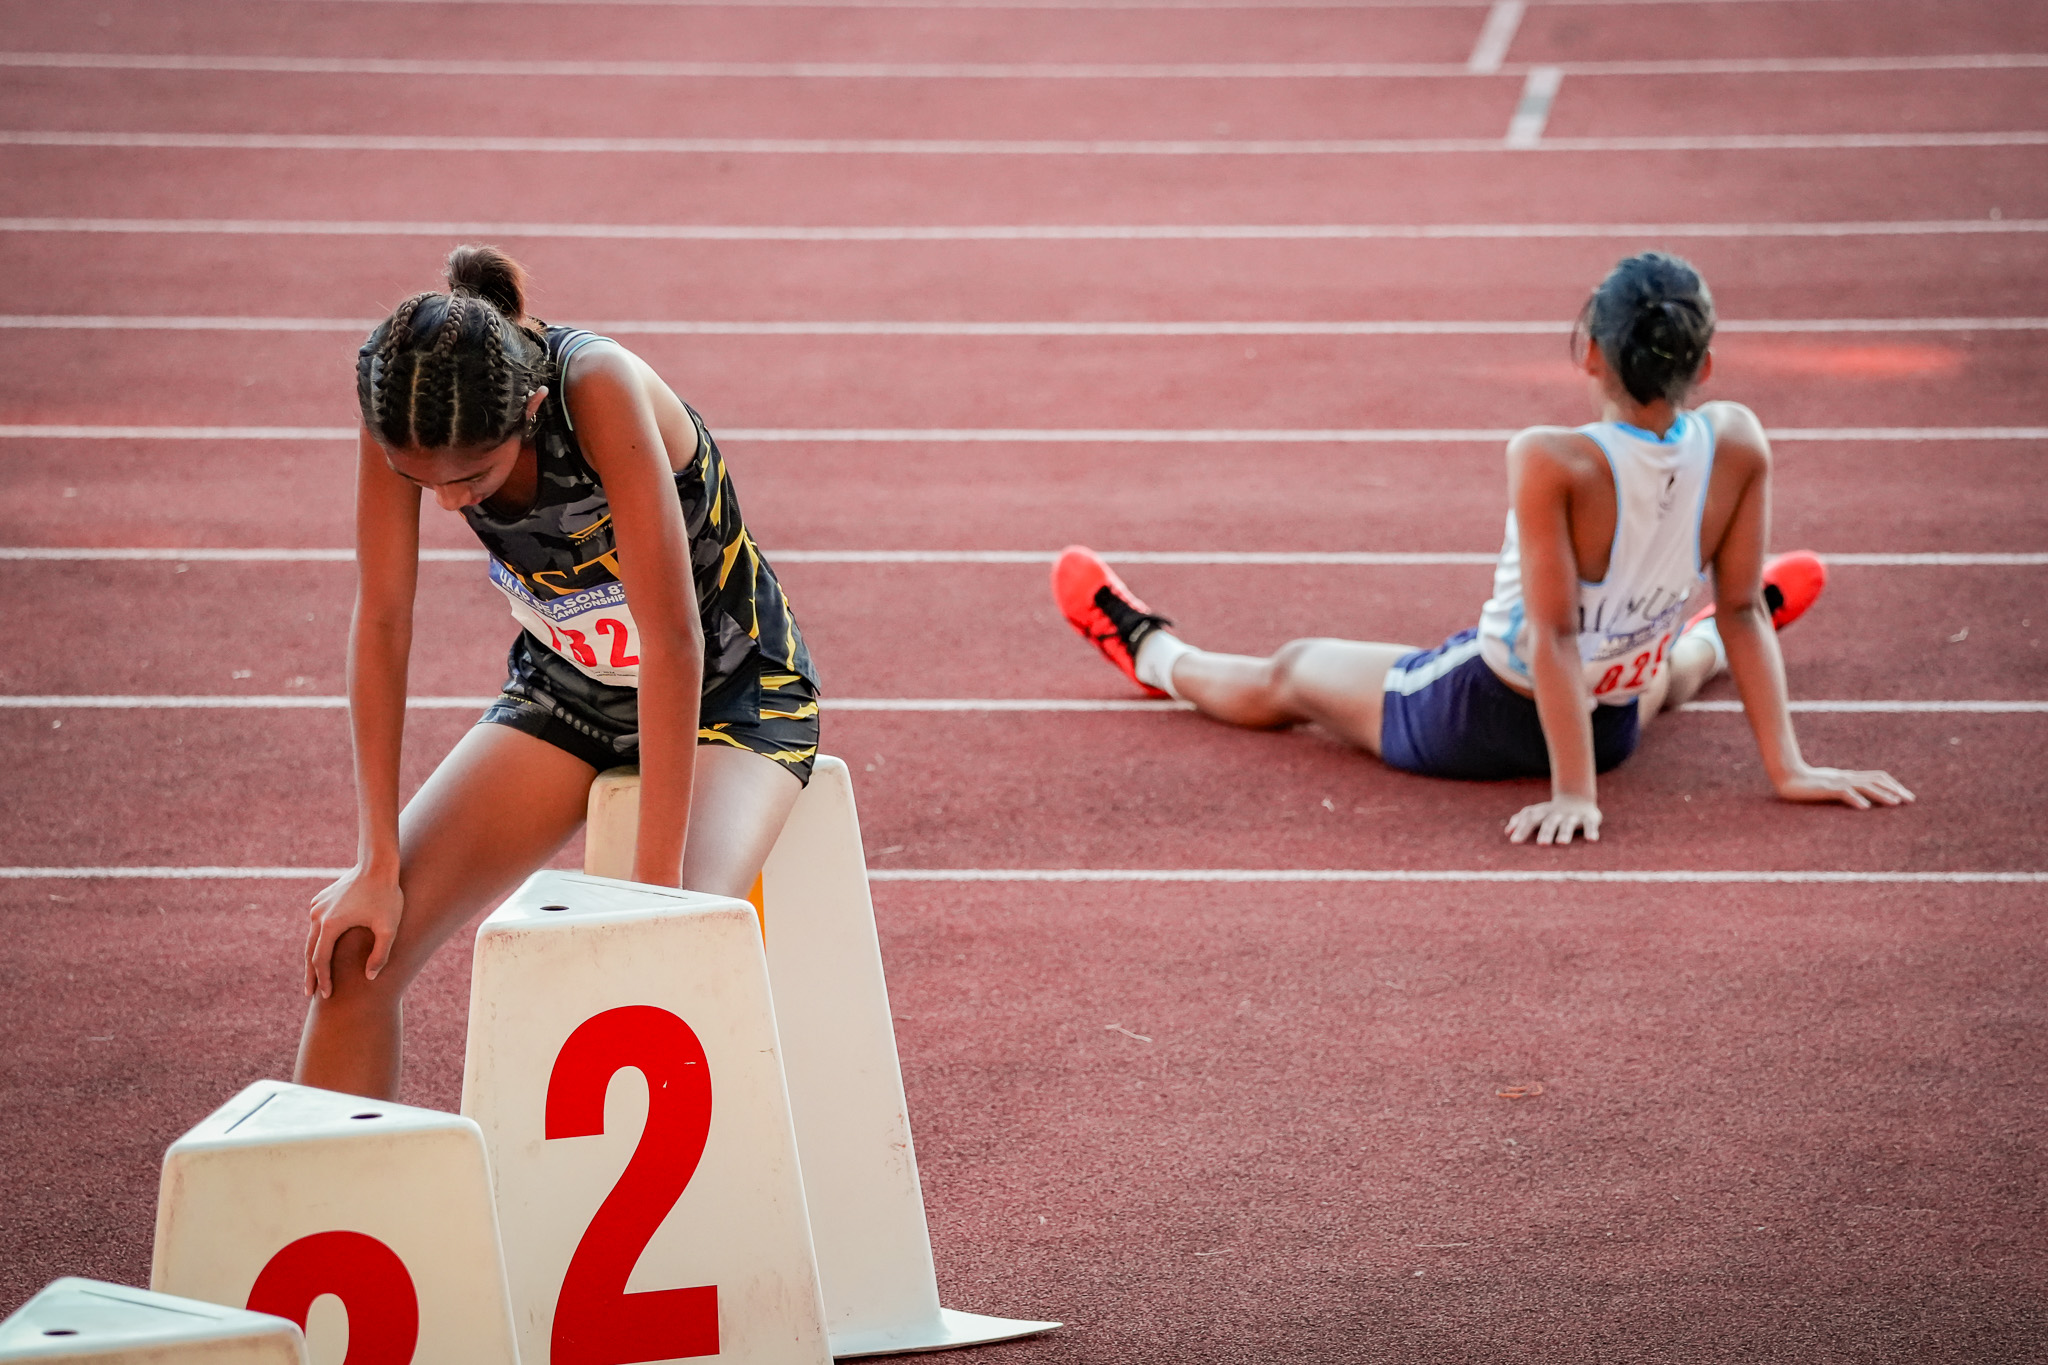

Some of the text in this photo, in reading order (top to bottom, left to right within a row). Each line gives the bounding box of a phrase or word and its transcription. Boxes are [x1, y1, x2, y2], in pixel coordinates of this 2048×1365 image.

[499, 568, 531, 601] UAAP
[532, 589, 605, 614] SEASON
[545, 1004, 720, 1365] 2
